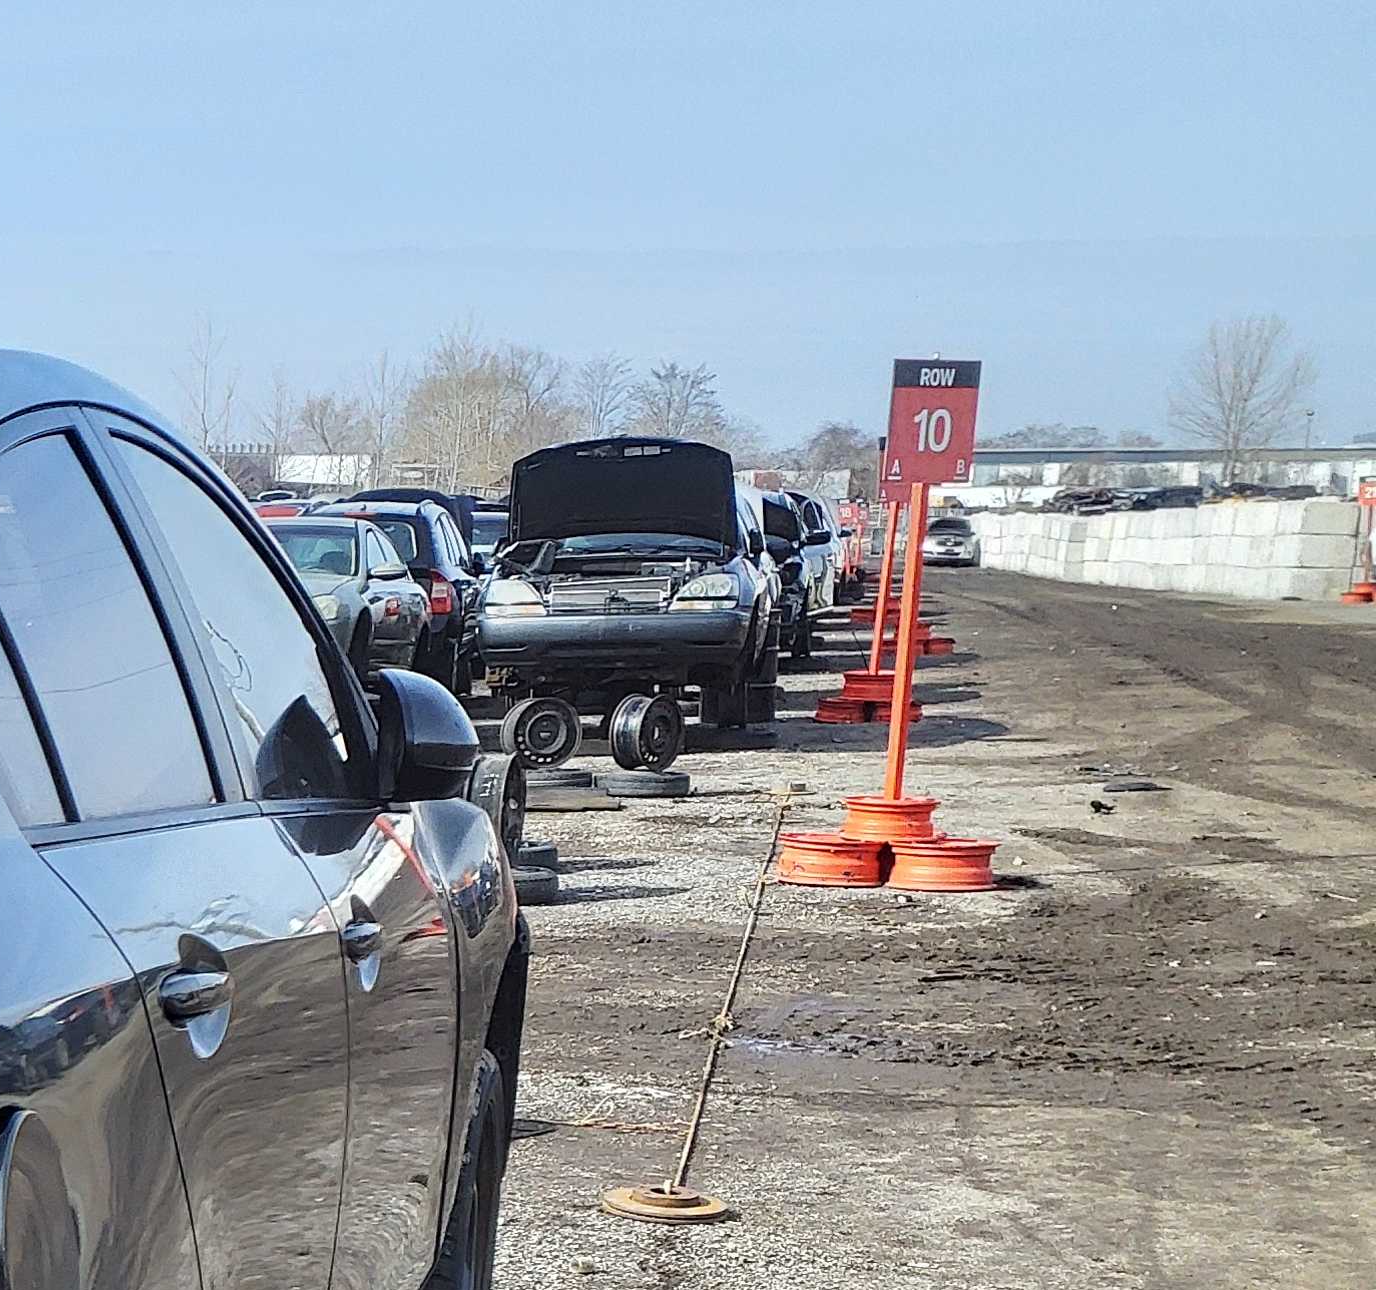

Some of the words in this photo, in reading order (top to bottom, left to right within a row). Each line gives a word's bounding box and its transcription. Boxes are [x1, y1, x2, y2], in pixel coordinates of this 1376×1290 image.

[919, 367, 956, 387] ROW
[913, 408, 952, 453] 10
[891, 459, 901, 475] A
[955, 459, 966, 474] B
